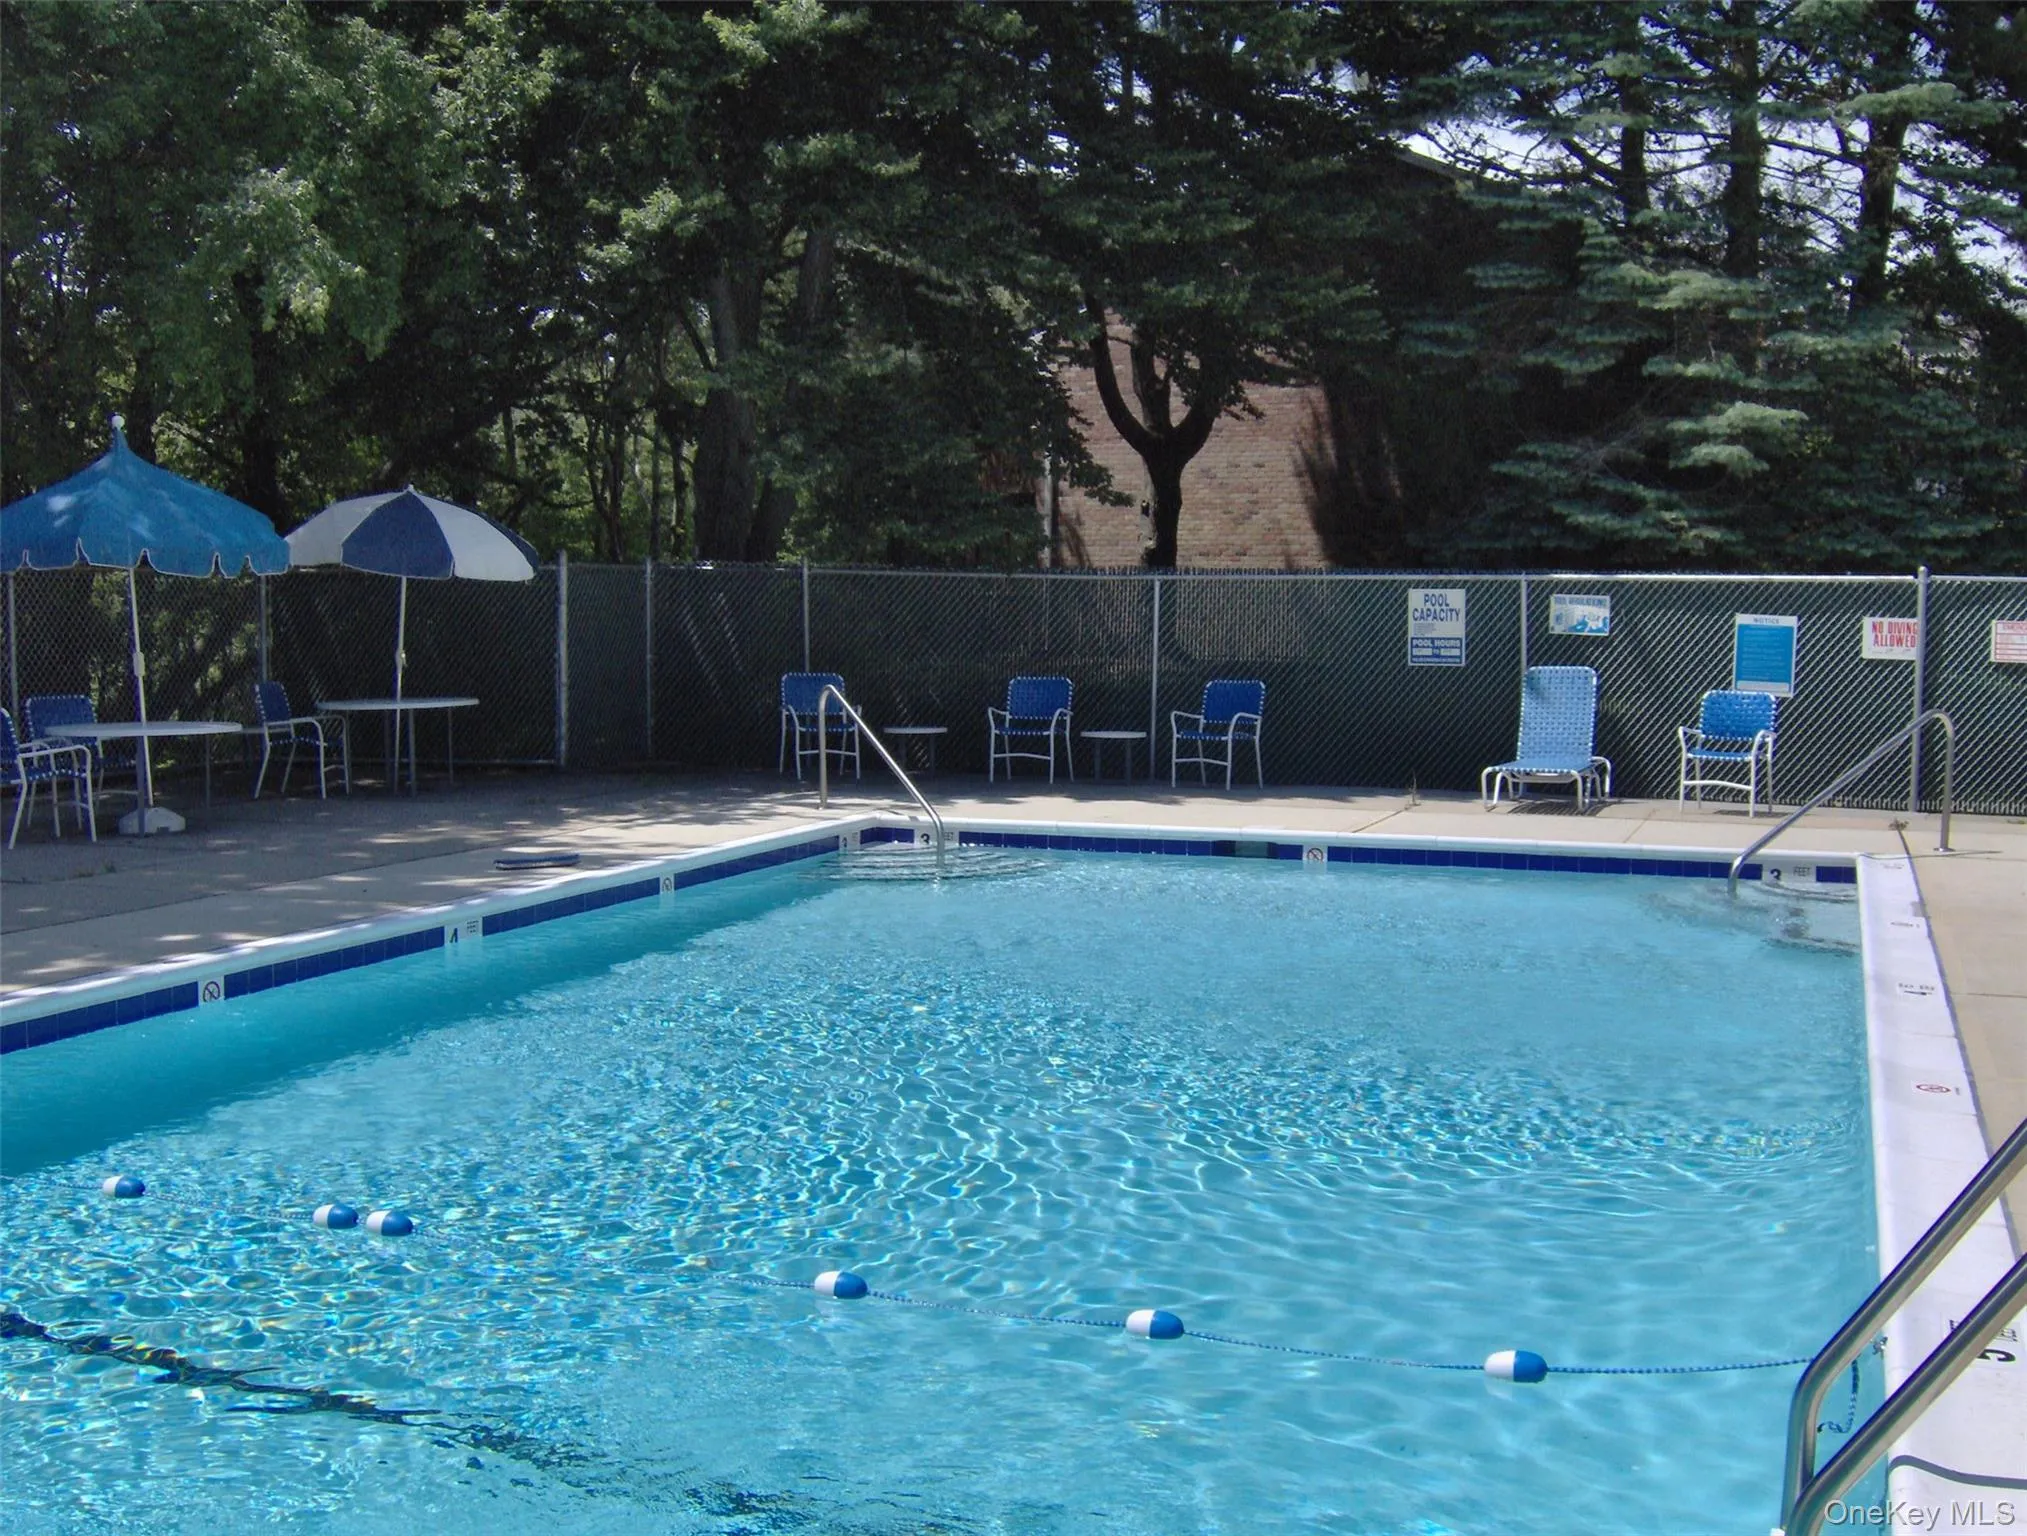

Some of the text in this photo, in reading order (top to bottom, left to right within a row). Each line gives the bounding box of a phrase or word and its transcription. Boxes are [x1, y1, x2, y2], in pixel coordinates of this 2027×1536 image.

[1424, 593, 1450, 607] POOL
[1413, 608, 1460, 621] CAPACITY
[1872, 621, 1883, 634] NO
[1413, 639, 1433, 647] POOL
[1873, 634, 1916, 648] ALLOWED
